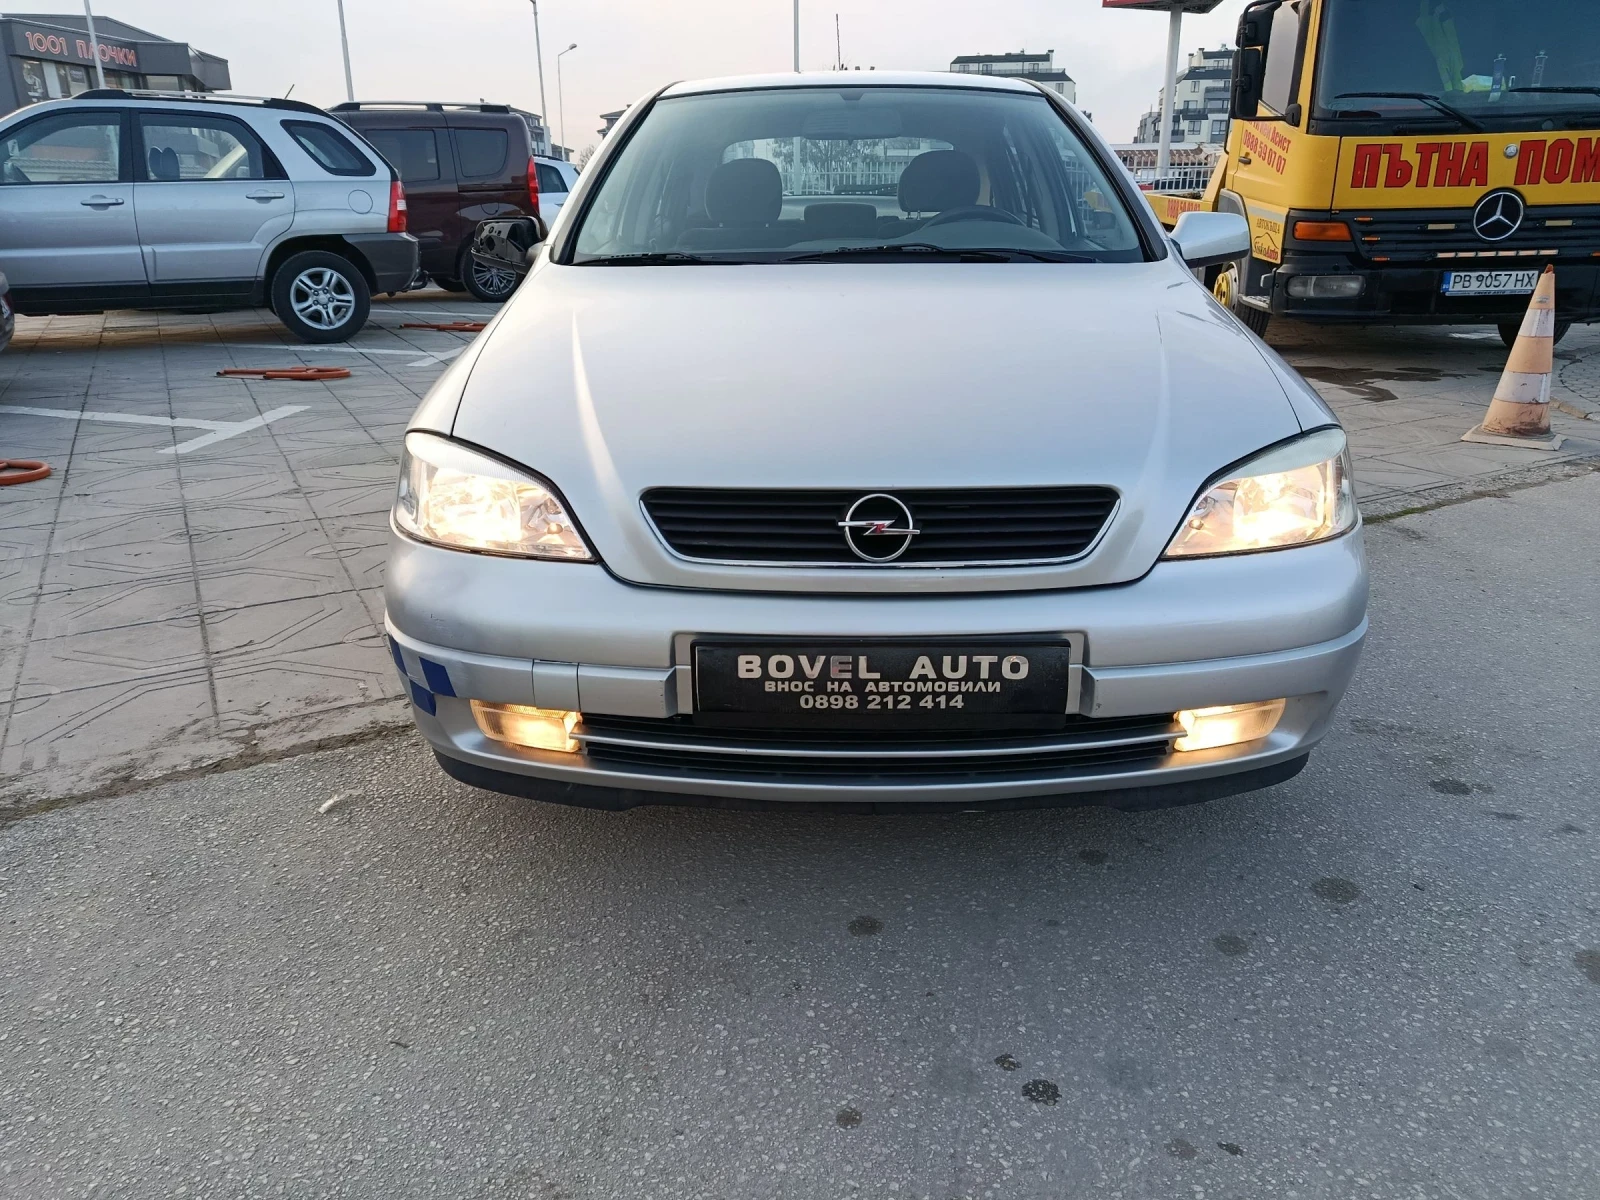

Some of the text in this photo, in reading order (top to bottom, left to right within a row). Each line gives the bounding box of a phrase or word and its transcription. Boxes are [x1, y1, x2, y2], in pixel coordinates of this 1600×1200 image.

[25, 31, 68, 56] 1001
[1258, 141, 1268, 161] 59
[1267, 148, 1277, 168] 07
[1276, 155, 1287, 175] 07
[1350, 136, 1600, 188] ПЪТНА ПОМ
[1452, 272, 1536, 289] PB 9057 HX
[737, 654, 1029, 680] BOVEL AUTO
[764, 681, 1001, 693] ВНОС НА АВТОМОБИЛИ
[800, 694, 965, 710] 0898 212 414
